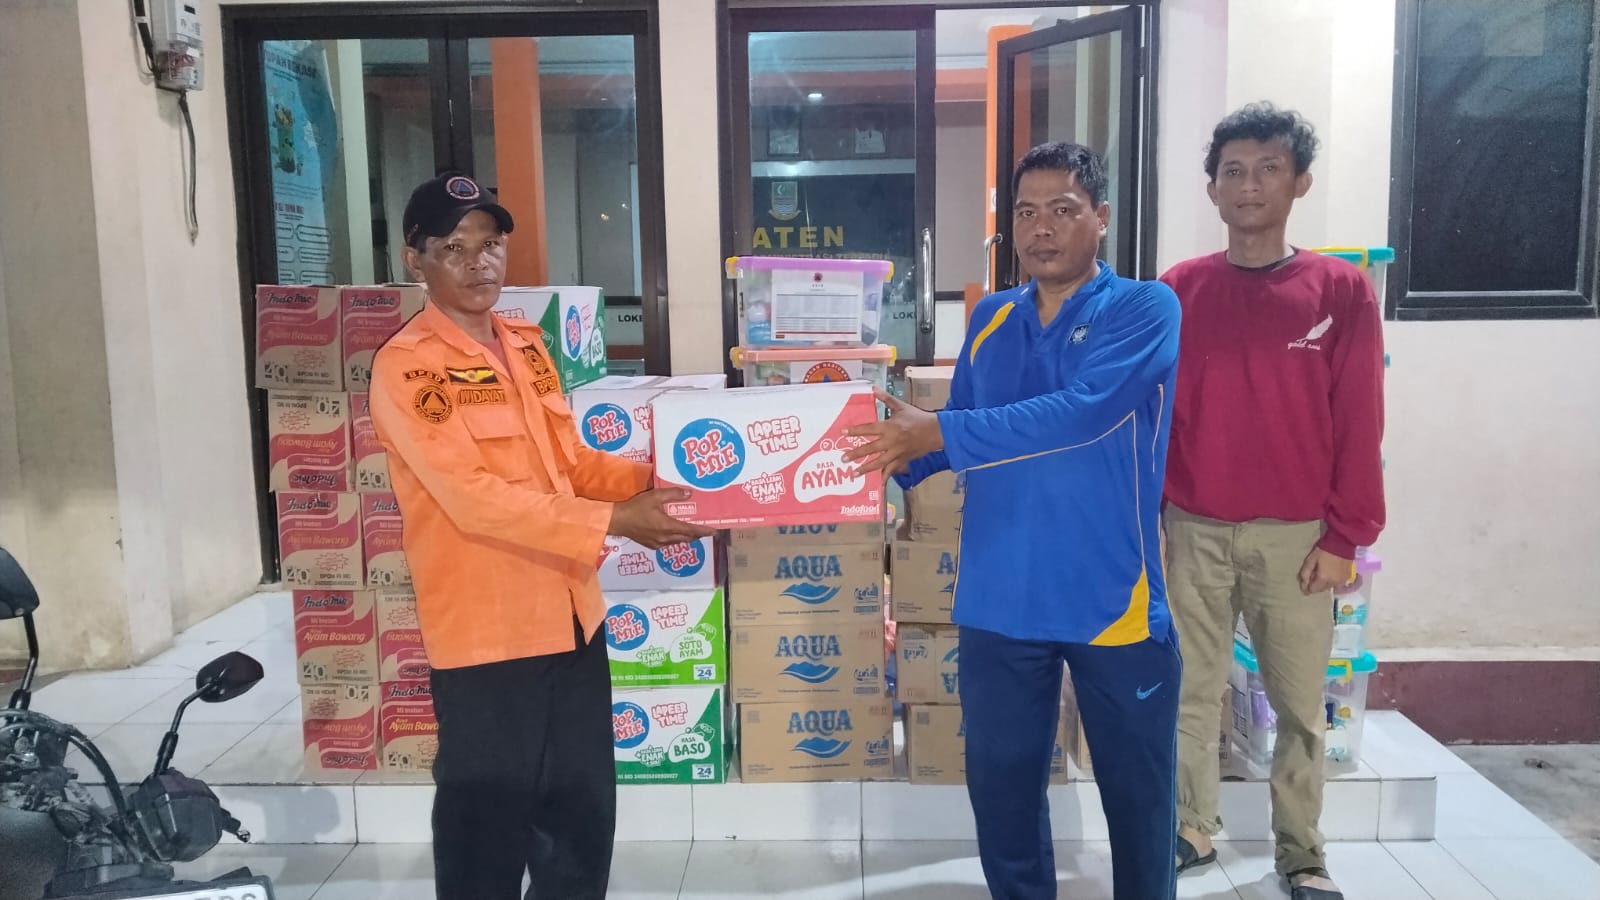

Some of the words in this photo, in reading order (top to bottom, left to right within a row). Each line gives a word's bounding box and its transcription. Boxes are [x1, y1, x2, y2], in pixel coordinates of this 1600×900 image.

[588, 411, 616, 434] POP
[747, 415, 801, 443] LAPEER
[596, 421, 628, 445] MIE
[681, 429, 721, 464] POP
[757, 433, 799, 455] TIME
[695, 443, 739, 478] MIE
[816, 461, 834, 470] RASA
[801, 465, 856, 490] AYAM
[751, 481, 785, 499] ENAK
[372, 498, 399, 512] Indo
[840, 503, 880, 515] Indofood
[617, 559, 655, 576] LAPEER
[618, 551, 649, 567] TIME
[672, 548, 700, 570] POP
[774, 554, 842, 582] AQUA
[650, 604, 688, 621] LAPEER
[607, 611, 634, 634] POP
[657, 615, 687, 630] TIME
[329, 631, 366, 643] Bawang
[615, 621, 645, 643] MIE
[679, 640, 703, 650] SOTO
[679, 648, 704, 658] AYAM
[775, 634, 842, 661] AQUA
[696, 668, 713, 677] 24
[651, 702, 688, 719] LAPEER
[388, 721, 414, 734] Ayam
[414, 720, 439, 731] Bawa
[658, 713, 686, 728] TIME
[786, 709, 853, 736] AQUA
[615, 719, 644, 742] MIE
[673, 742, 705, 757] BASO
[696, 767, 712, 775] 24
